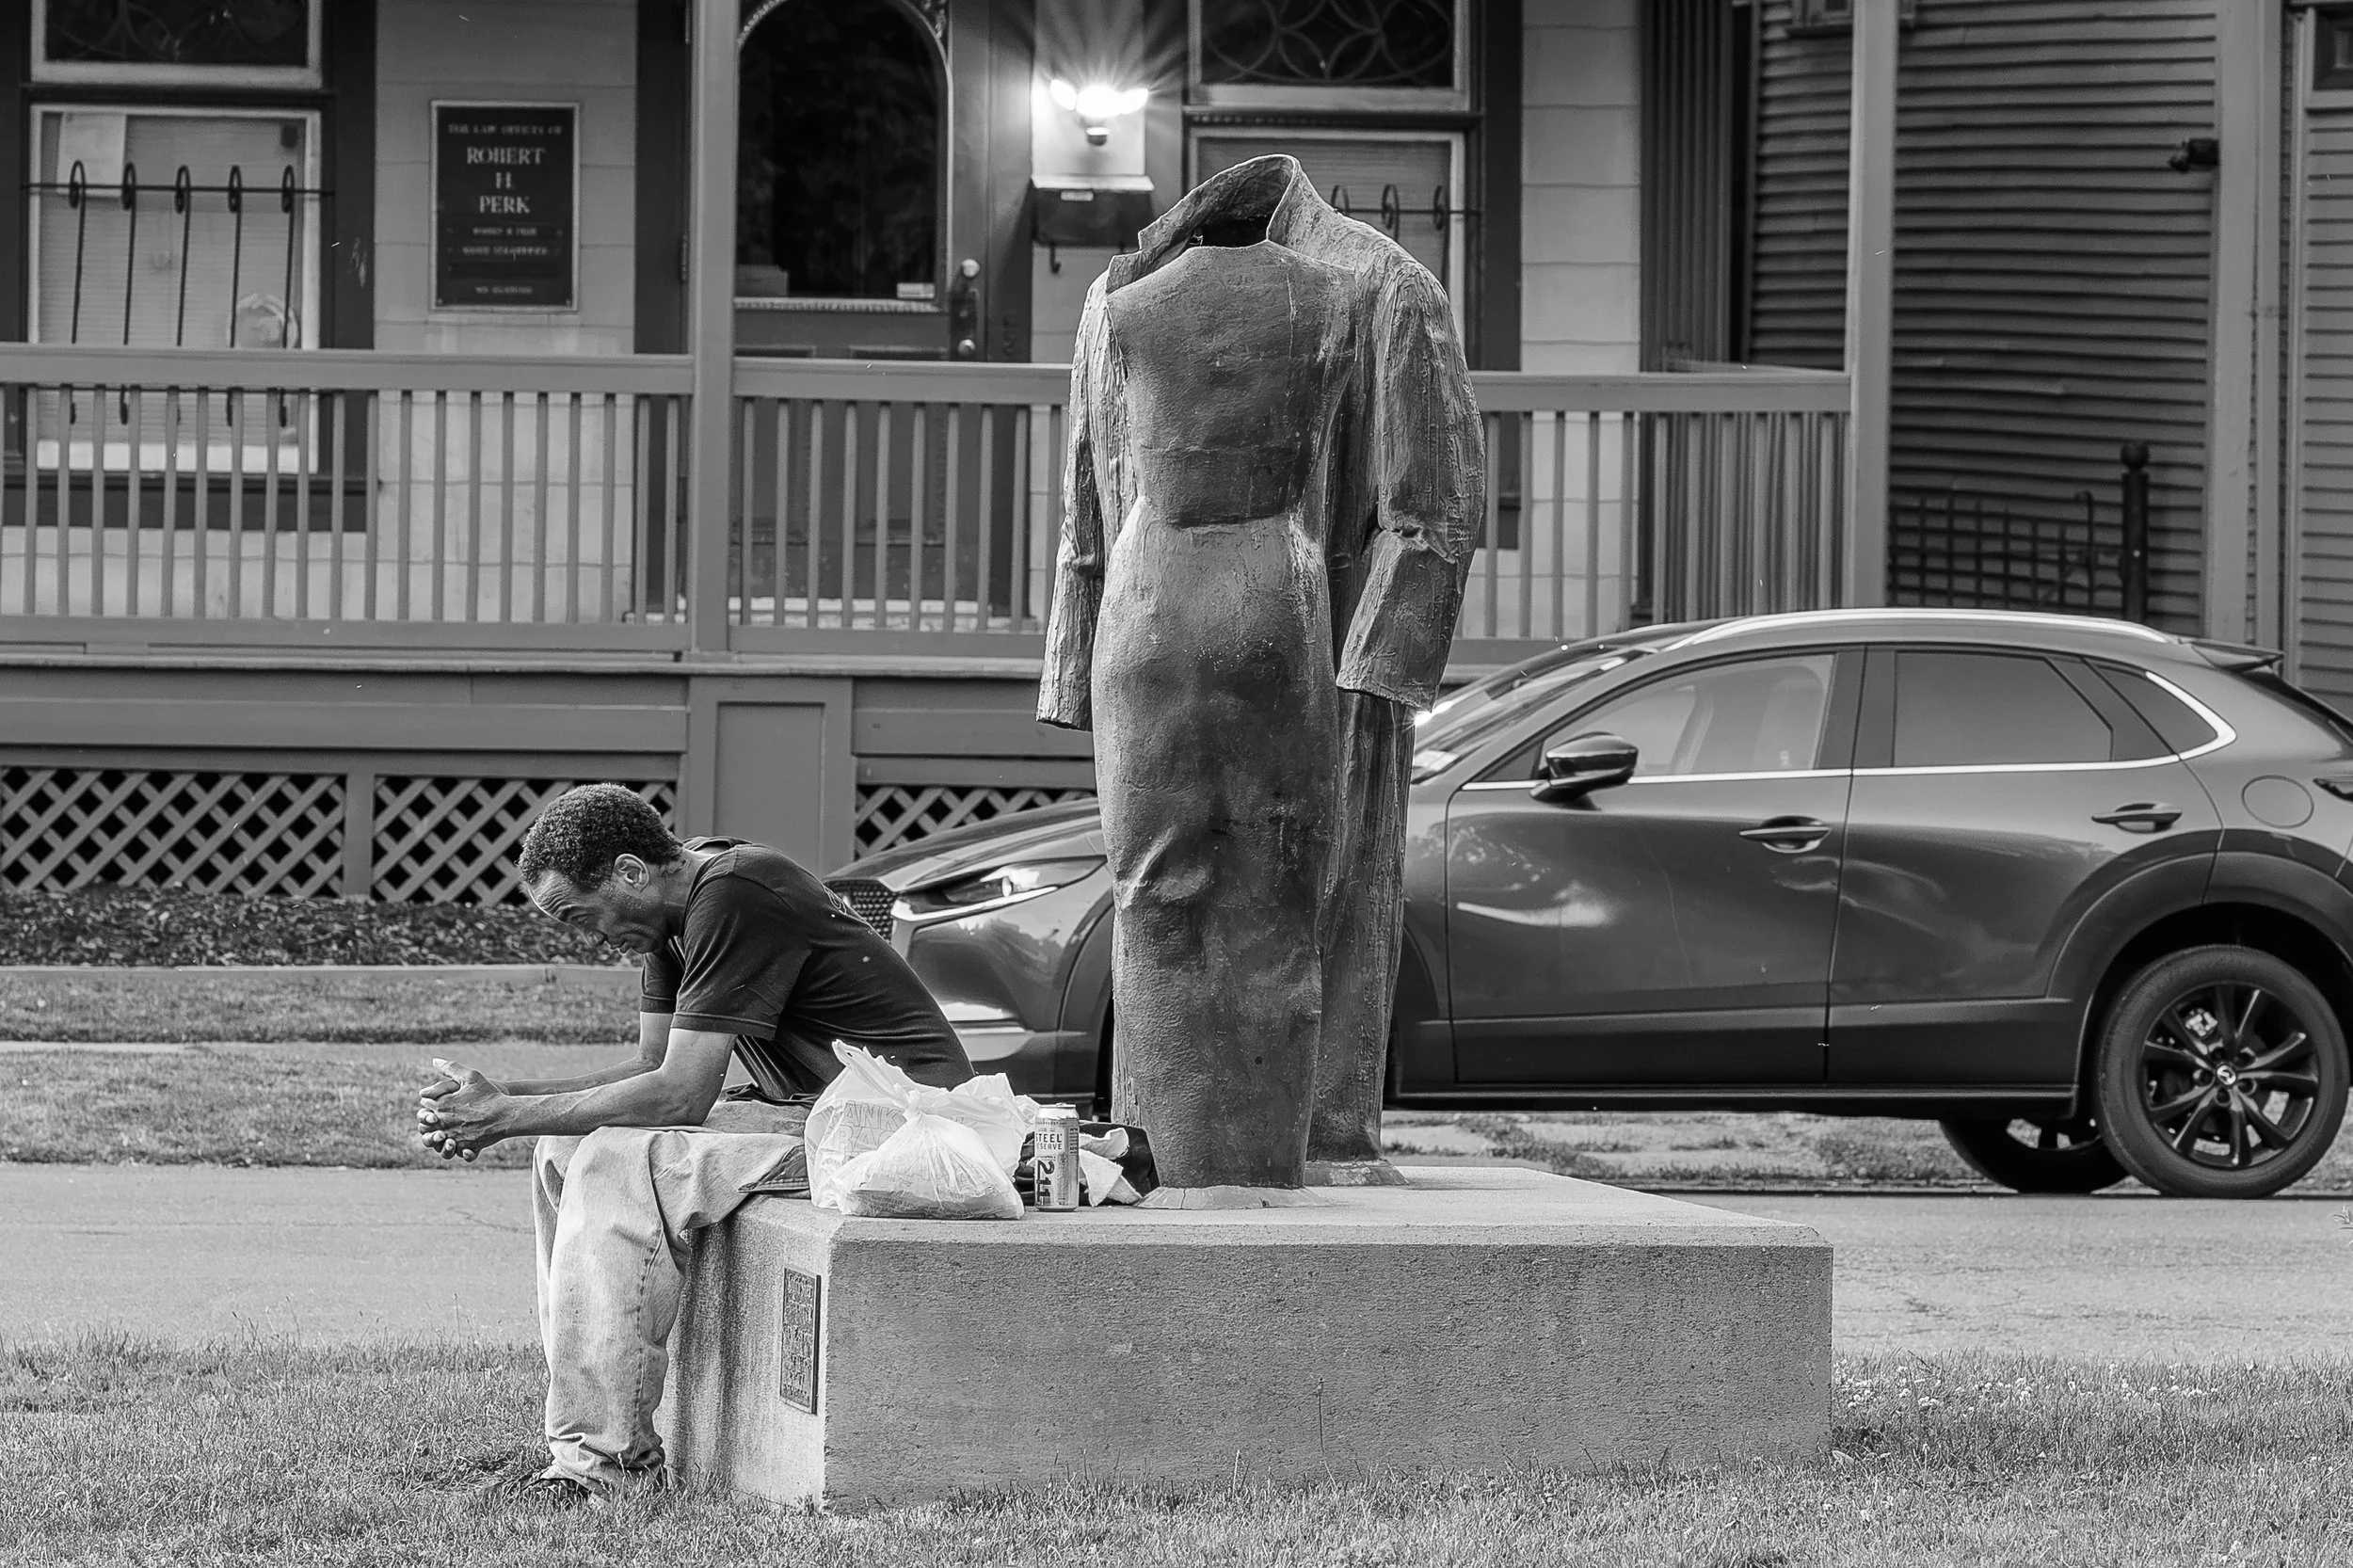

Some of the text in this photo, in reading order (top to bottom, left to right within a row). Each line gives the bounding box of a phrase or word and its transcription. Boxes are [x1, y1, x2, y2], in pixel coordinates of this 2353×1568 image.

[467, 146, 546, 165] ROBERT
[479, 196, 530, 214] PERK
[1037, 1160, 1055, 1205] 211
